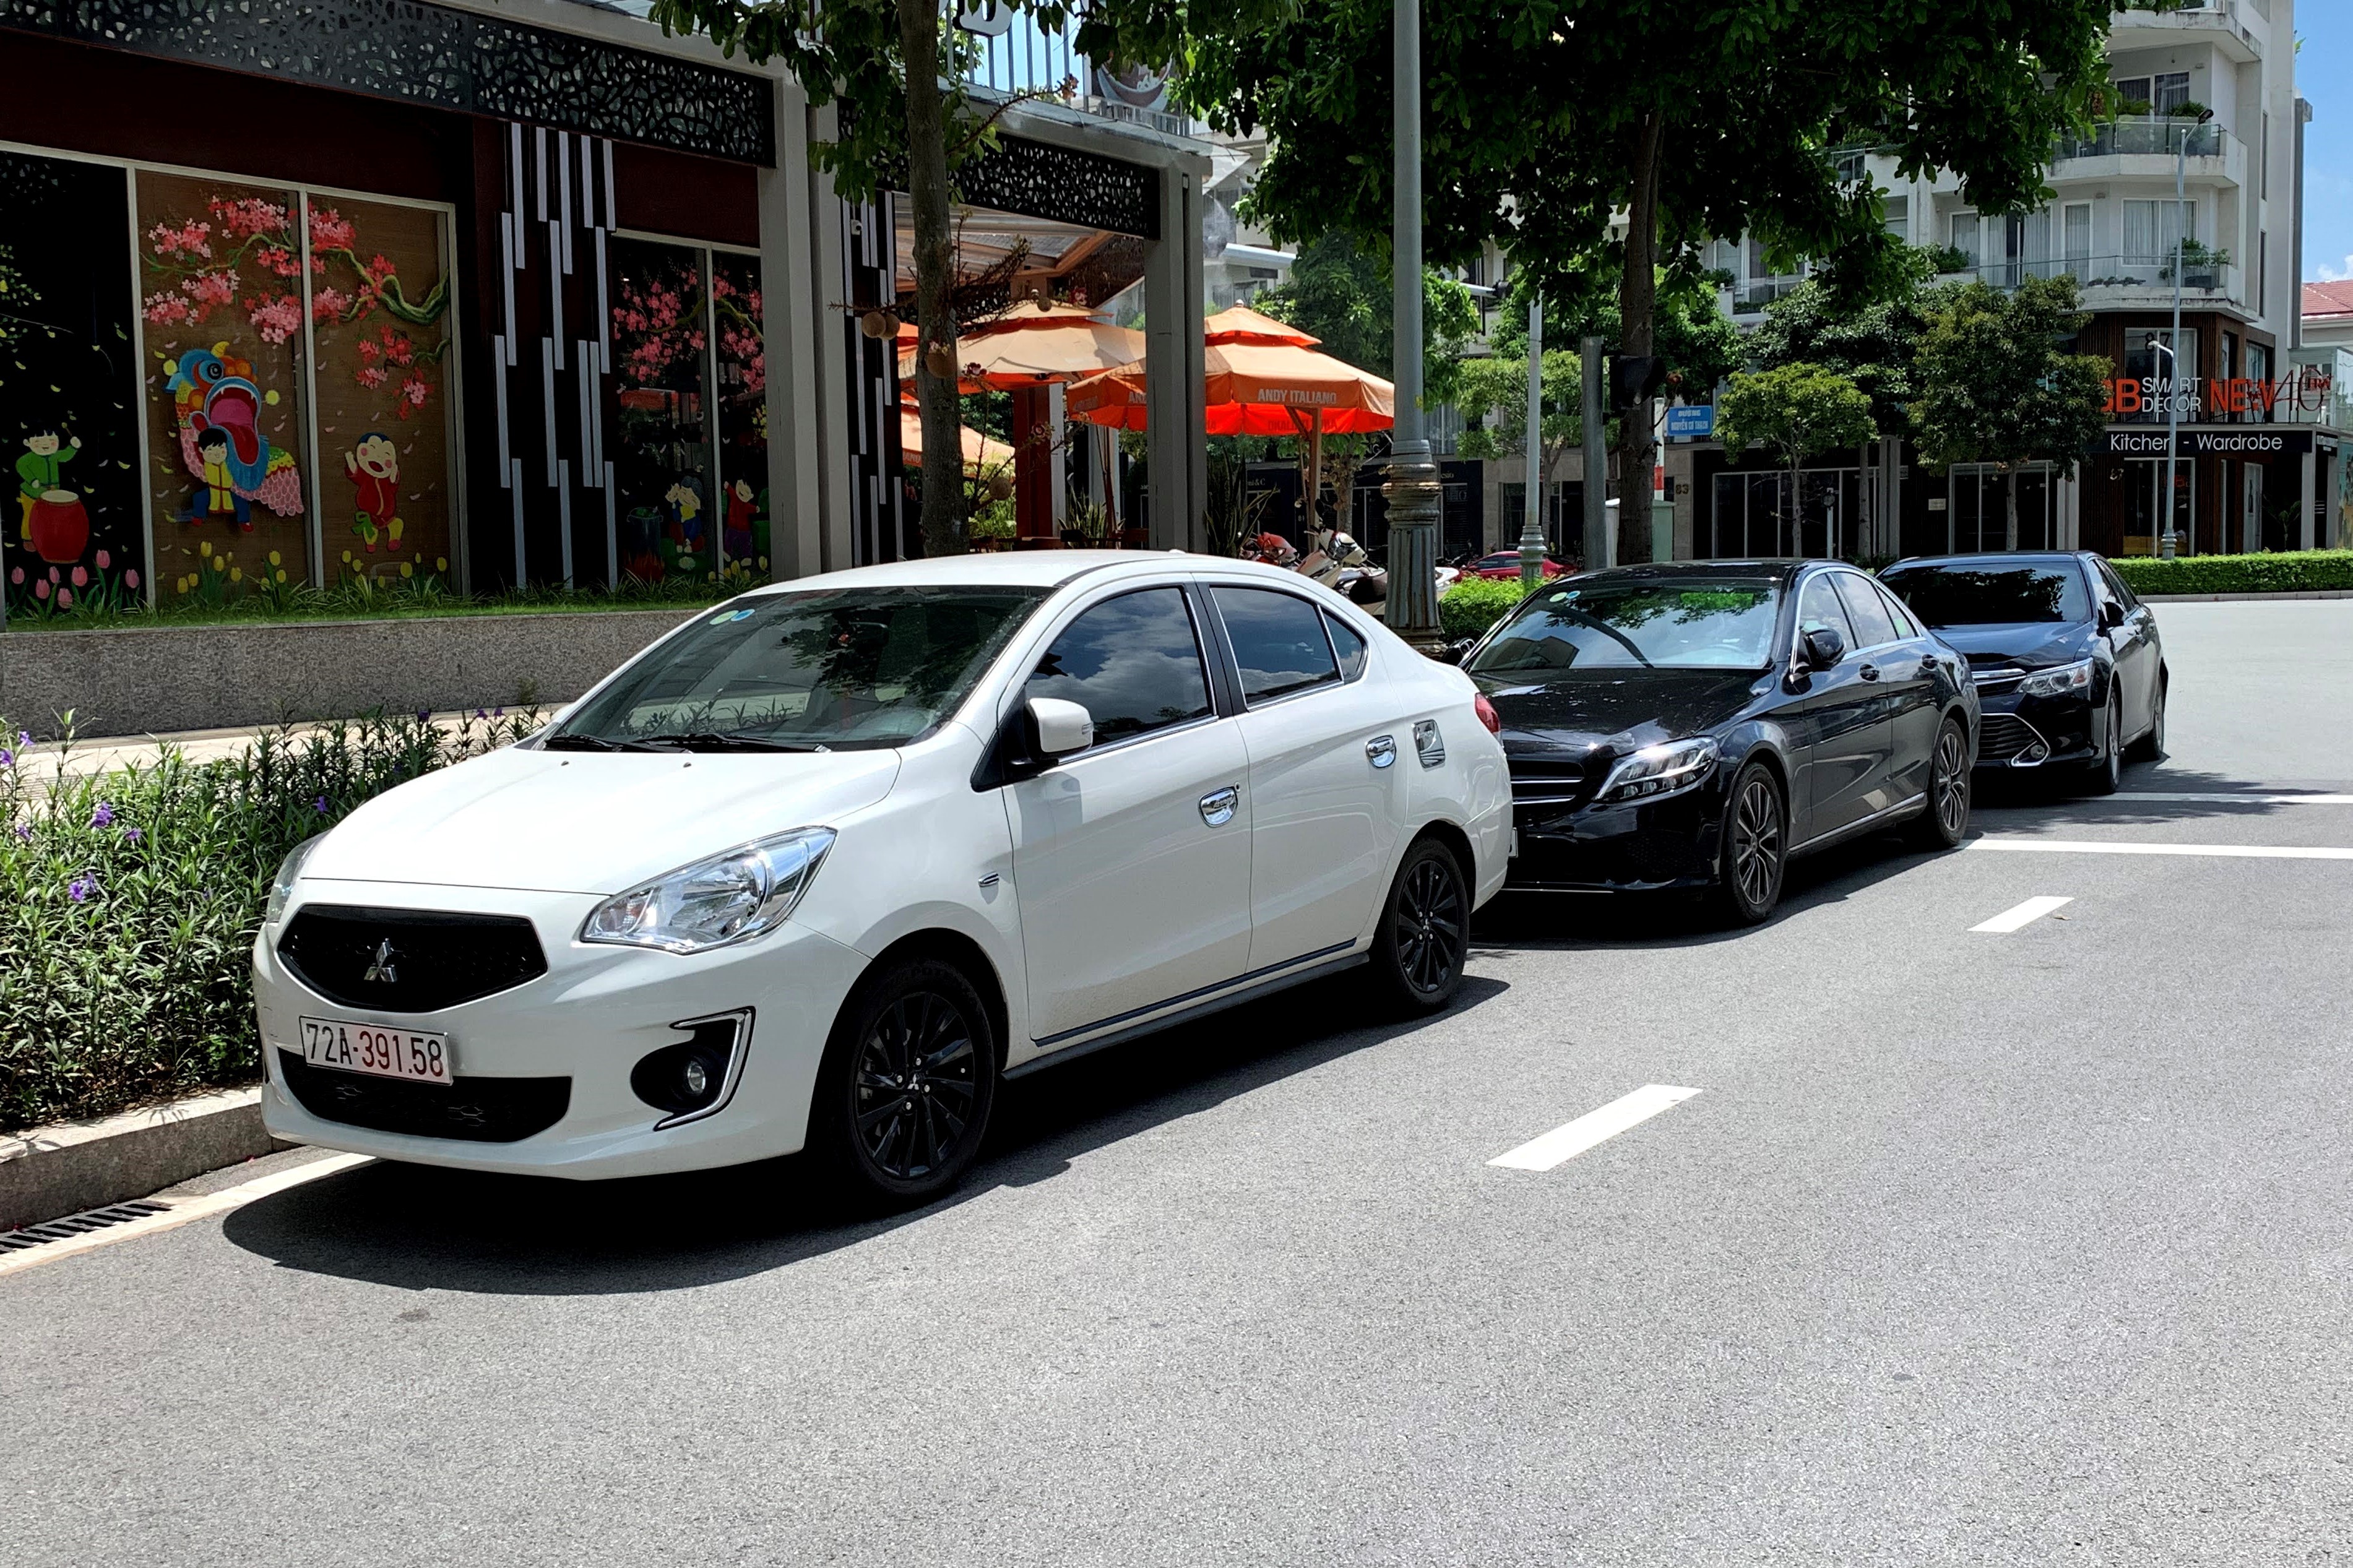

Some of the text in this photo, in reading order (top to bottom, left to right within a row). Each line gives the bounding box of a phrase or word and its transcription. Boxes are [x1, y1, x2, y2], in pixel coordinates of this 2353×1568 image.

[1258, 389, 1337, 404] ANDY ITALIANO
[2196, 433, 2282, 450] Wardrobe
[306, 1023, 444, 1077] 72A-391.58
